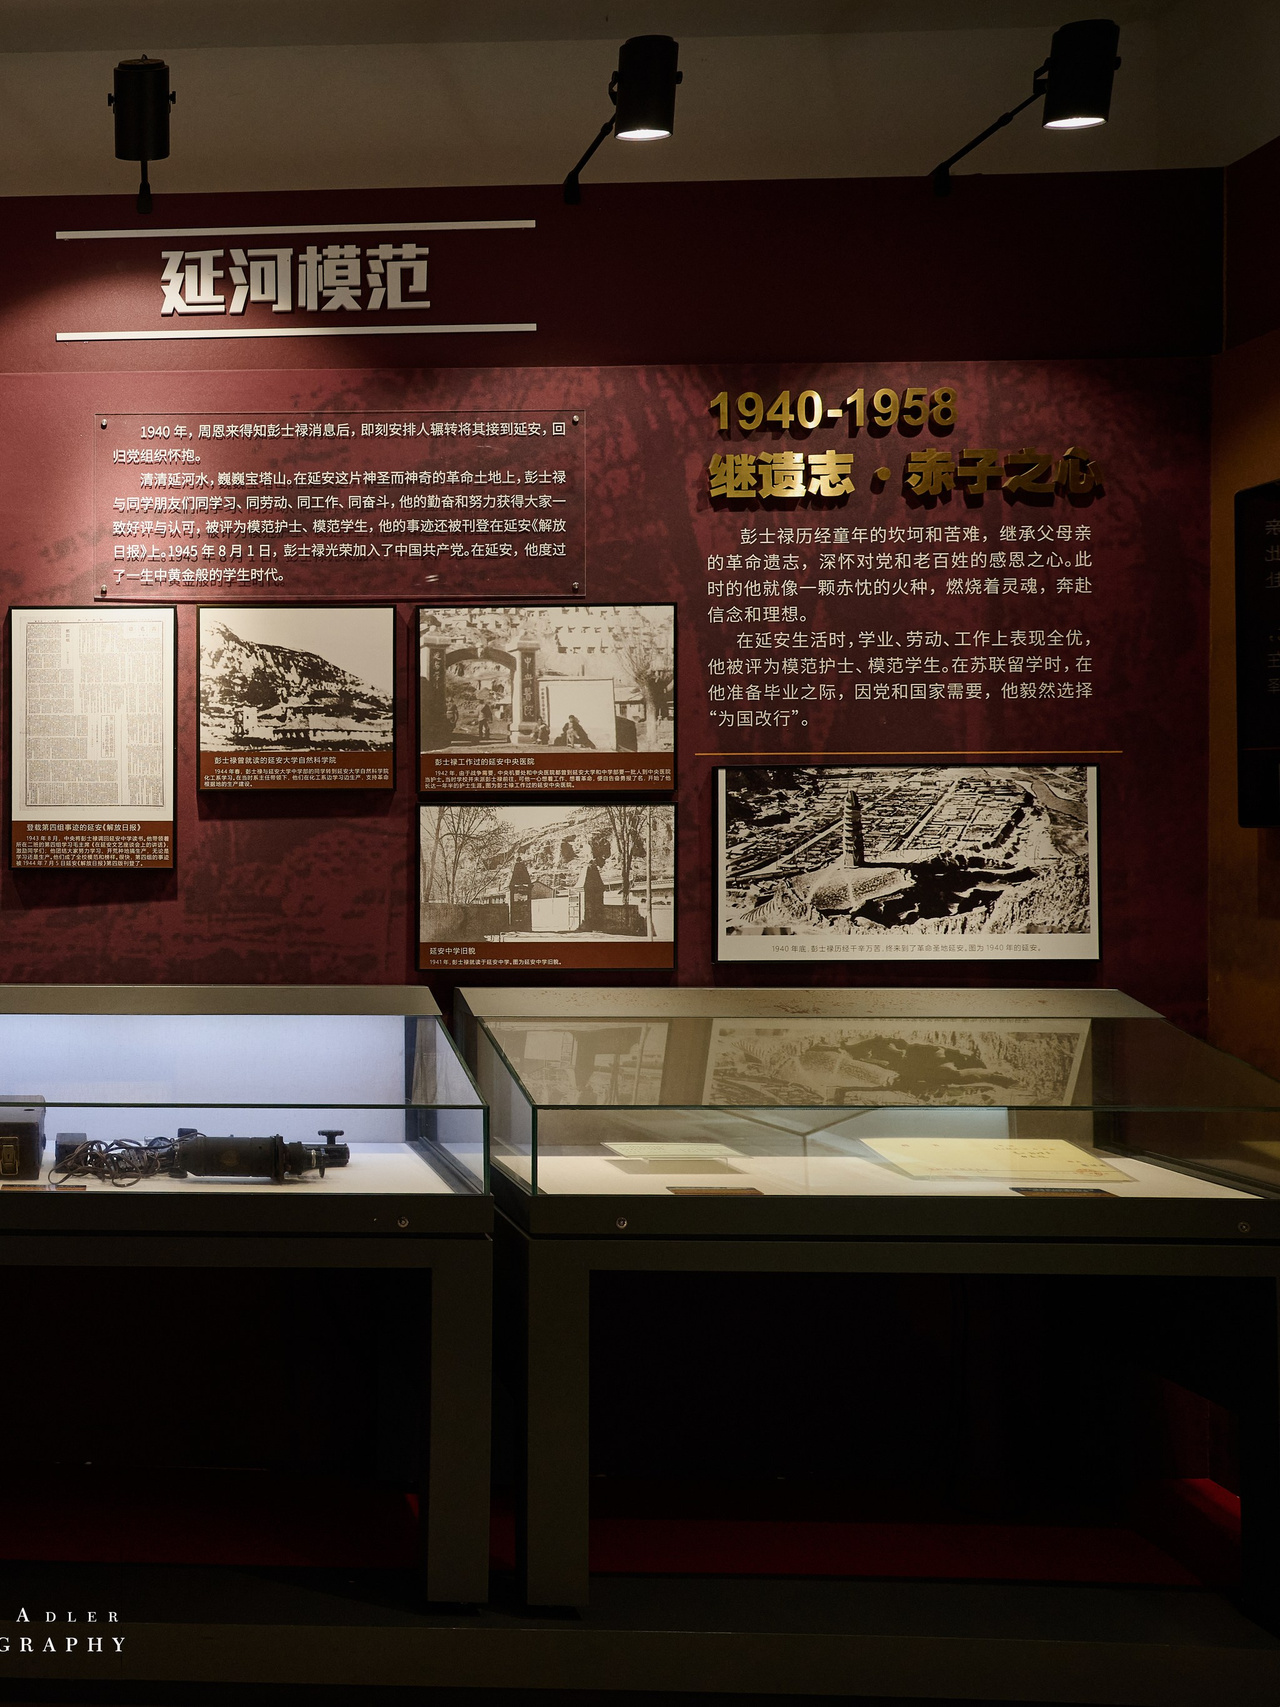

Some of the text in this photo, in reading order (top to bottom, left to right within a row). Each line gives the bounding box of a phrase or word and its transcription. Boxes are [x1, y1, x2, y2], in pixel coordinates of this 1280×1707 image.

[160, 243, 430, 317] 延河模范
[710, 387, 958, 430] 1940-1958
[707, 605, 808, 624] 信念和理想。
[214, 756, 337, 765] 彭士禄曾就读的延安大学自然科学院
[434, 757, 535, 766] 彭士禄工作过的延安中央医院
[429, 946, 476, 955] 延安中学旧貌
